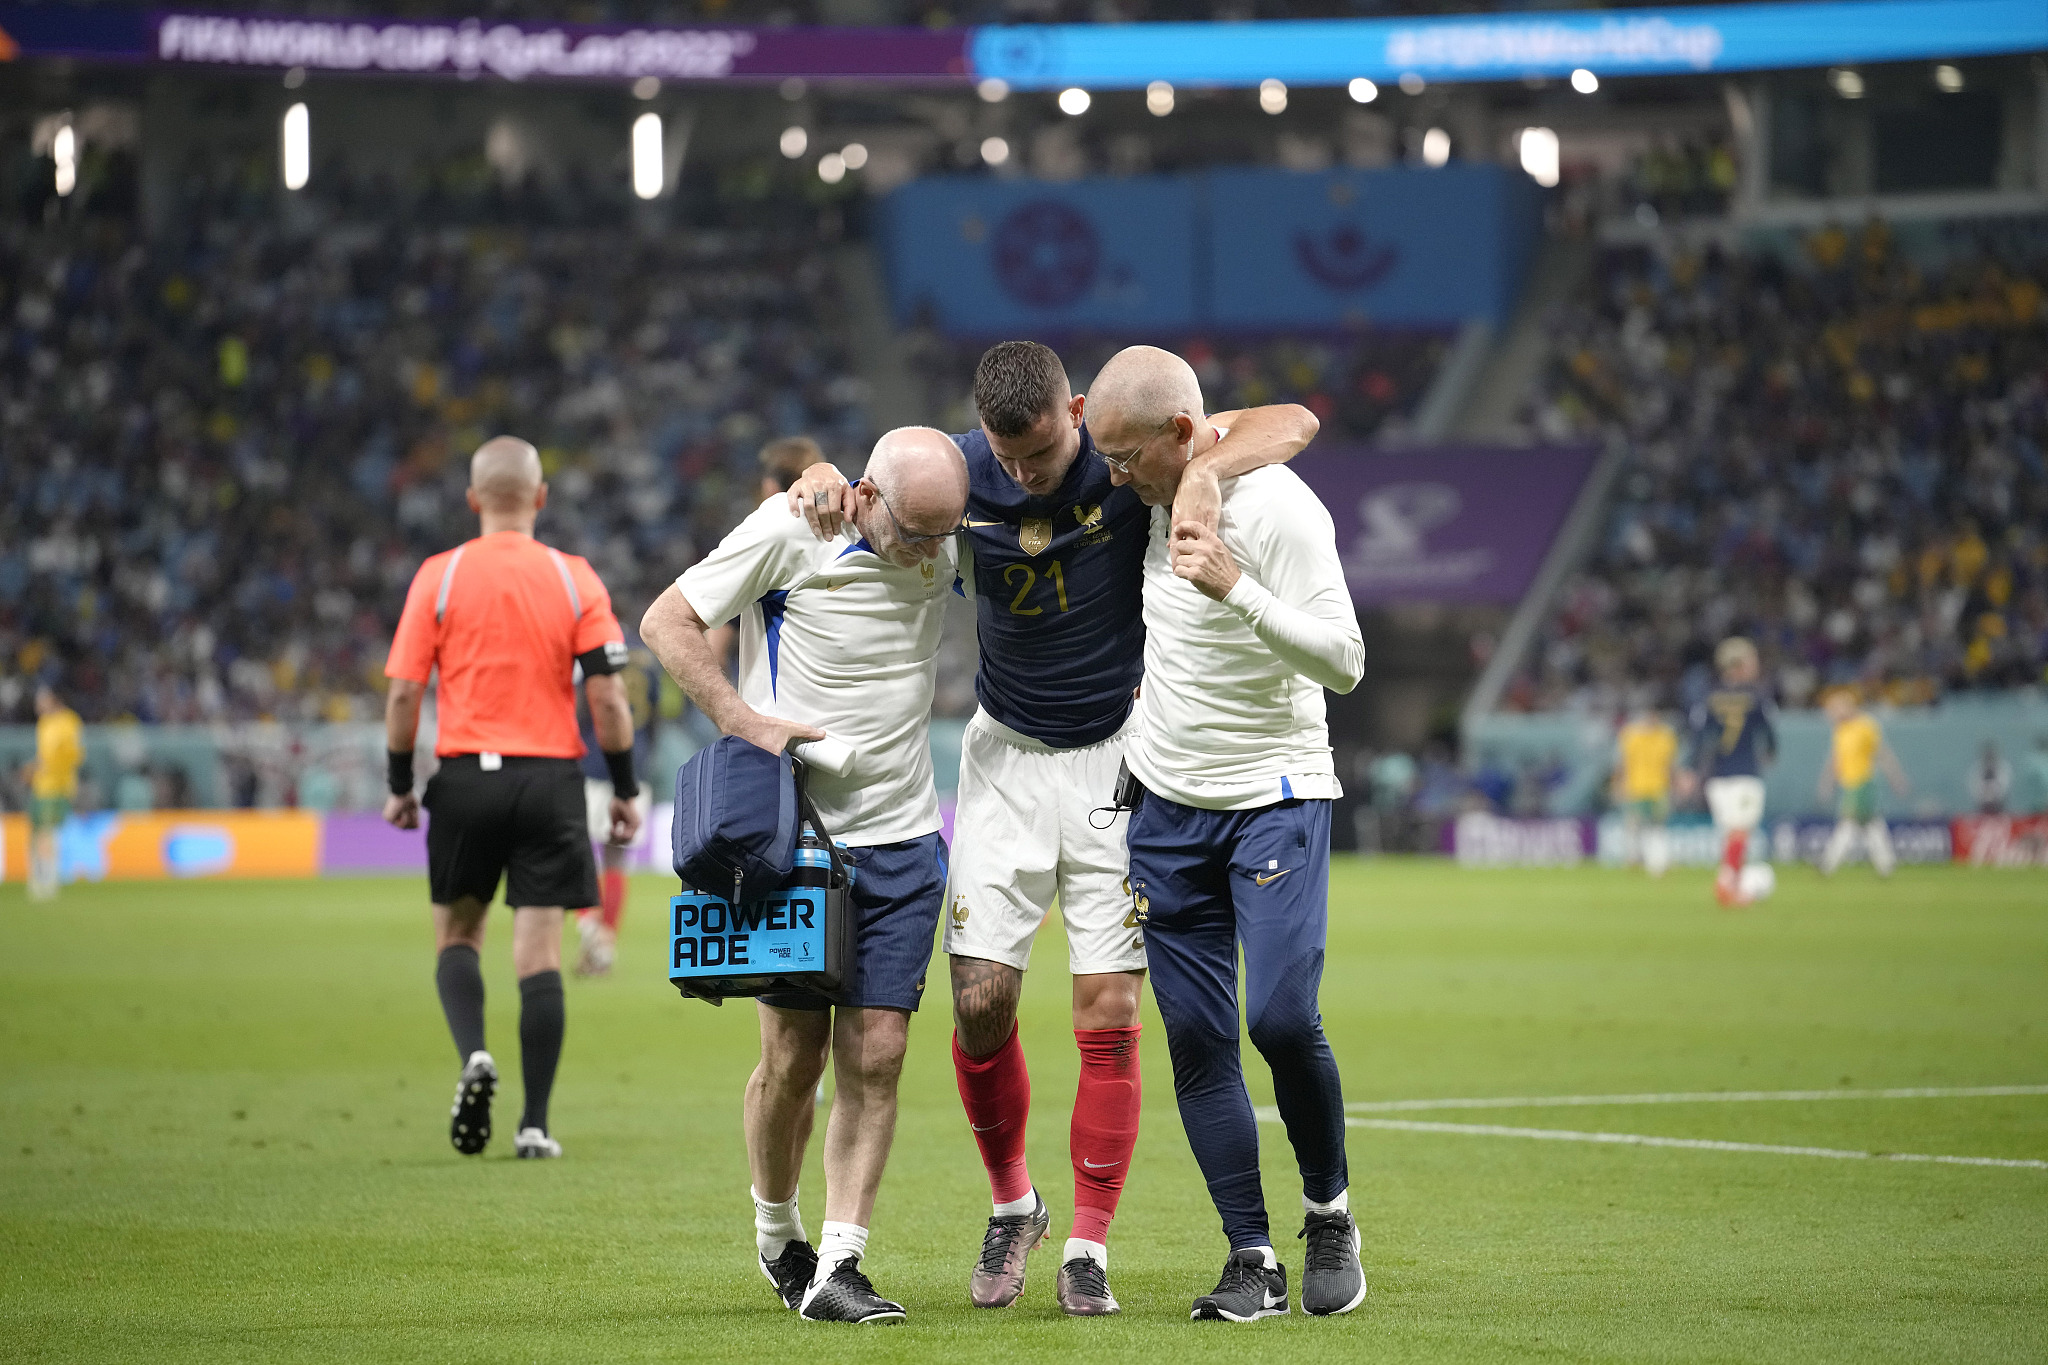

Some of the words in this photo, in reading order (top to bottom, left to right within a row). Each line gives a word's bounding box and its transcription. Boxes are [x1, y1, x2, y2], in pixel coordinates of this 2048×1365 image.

[159, 15, 242, 62] FIFA
[243, 19, 374, 68] WORLD
[373, 23, 454, 70] CUP
[1003, 560, 1069, 616] 21
[674, 898, 815, 936] POWER
